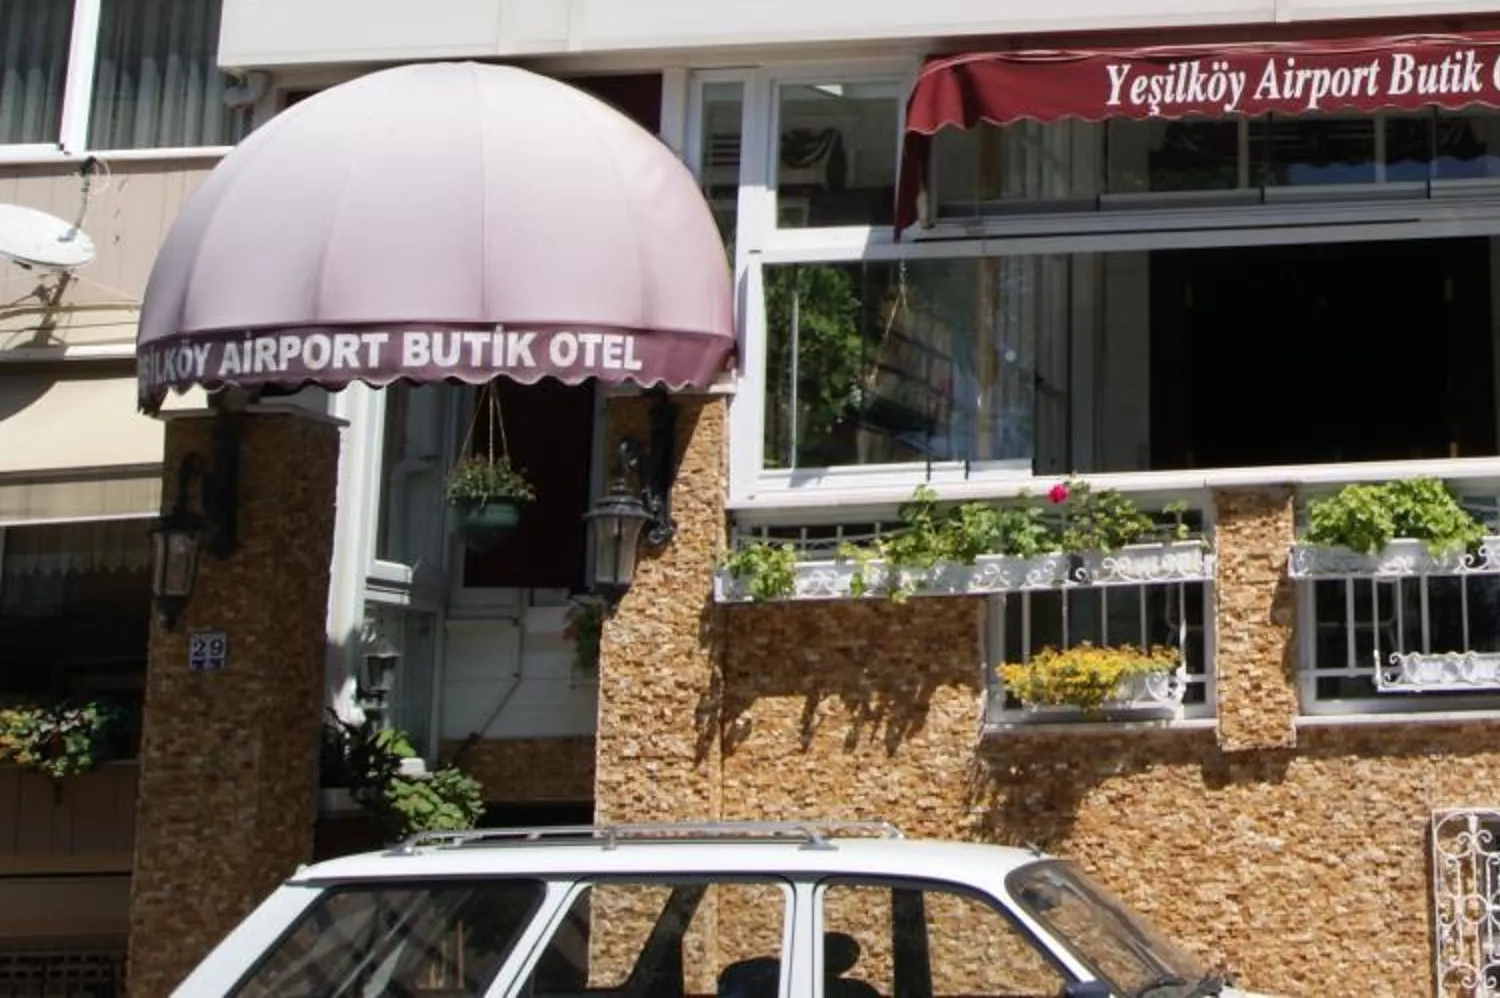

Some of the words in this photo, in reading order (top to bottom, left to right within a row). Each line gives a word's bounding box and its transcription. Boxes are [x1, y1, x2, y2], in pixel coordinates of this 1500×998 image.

[1106, 61, 1245, 116] Yeşilköy
[1254, 57, 1380, 110] Airport
[1388, 51, 1483, 94] Butik
[402, 326, 538, 369] BUTİK
[549, 333, 643, 370] OTEL
[193, 639, 223, 657] 29
